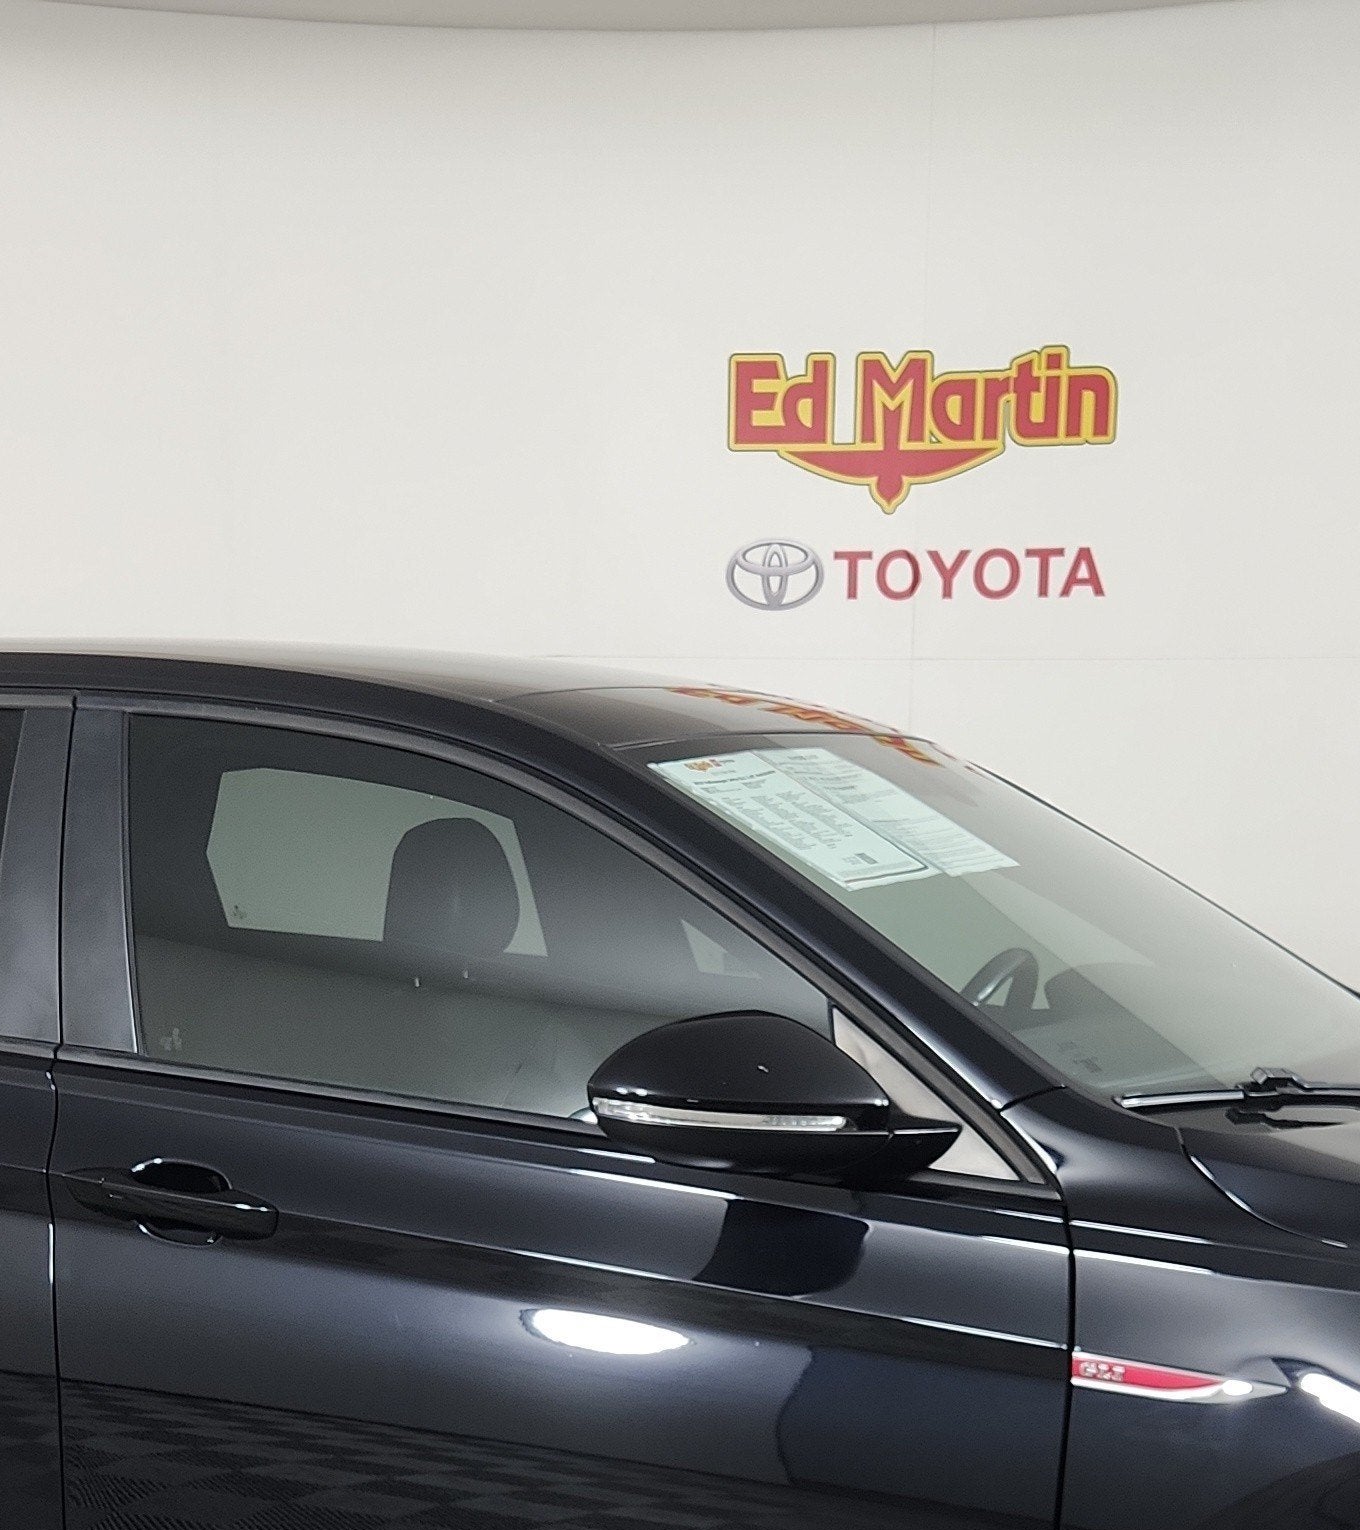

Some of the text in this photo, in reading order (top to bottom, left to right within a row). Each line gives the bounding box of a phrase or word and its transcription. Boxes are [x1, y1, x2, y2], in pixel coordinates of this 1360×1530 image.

[731, 349, 1115, 447] Ed Martin
[833, 547, 1105, 600] TOYOTA
